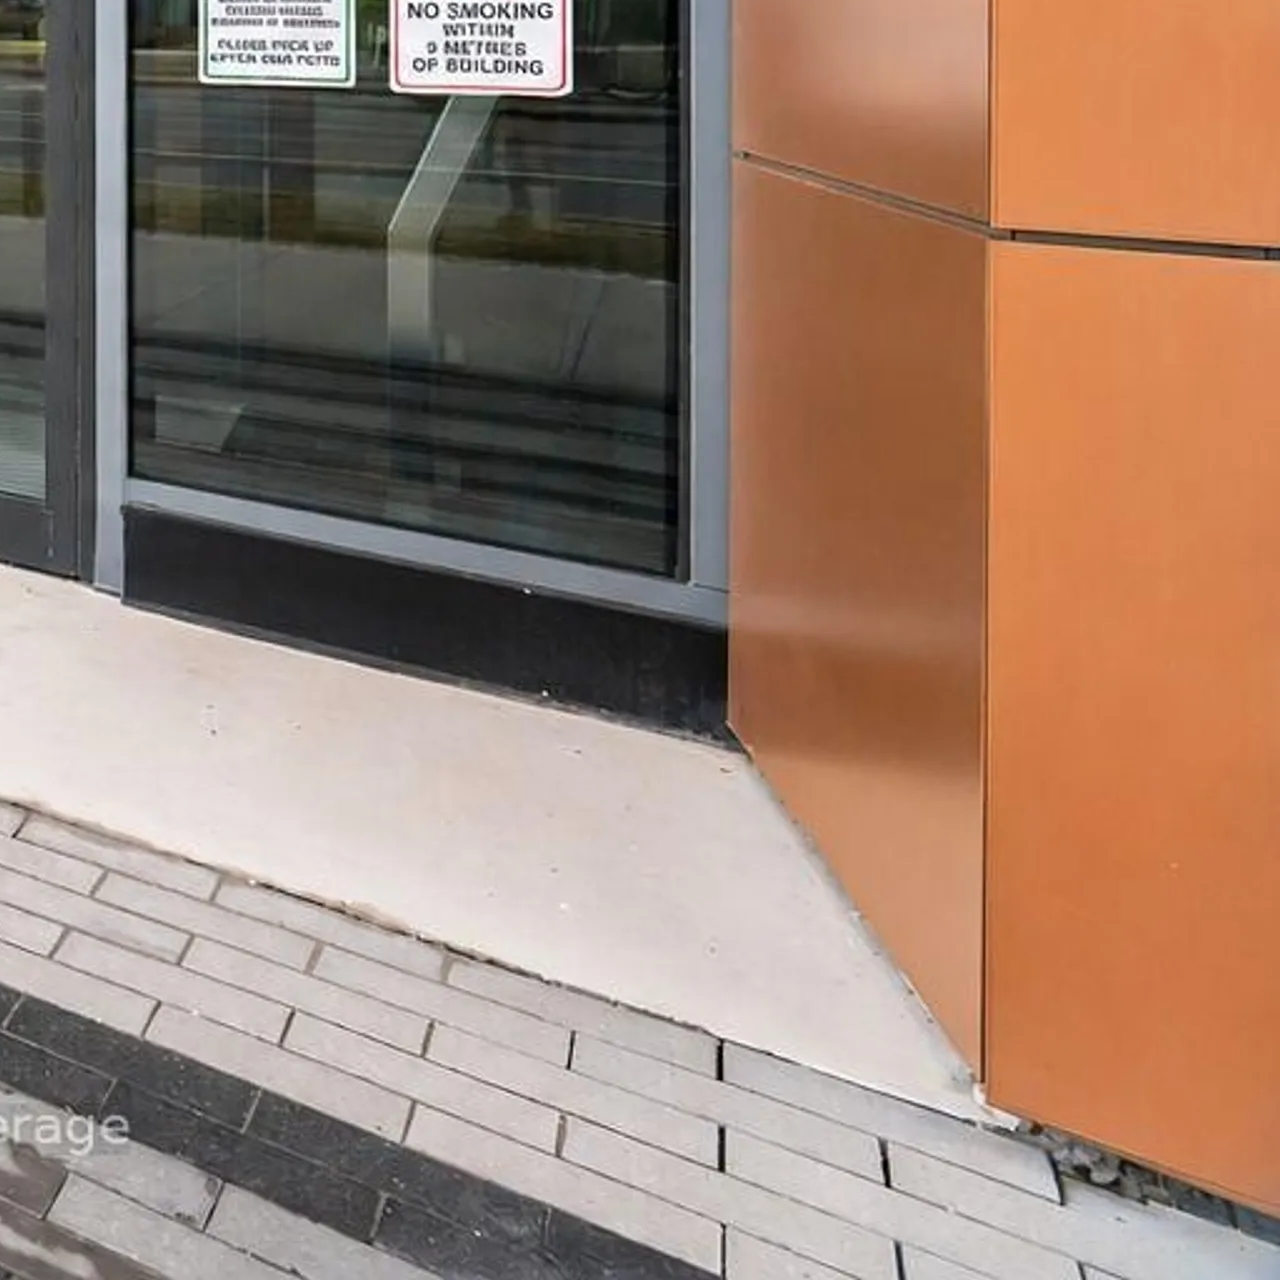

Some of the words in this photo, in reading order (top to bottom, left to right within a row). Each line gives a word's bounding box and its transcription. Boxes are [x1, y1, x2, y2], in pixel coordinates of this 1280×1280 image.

[407, 2, 439, 19] NO
[447, 2, 554, 20] SMOKING
[443, 22, 515, 38] WITHIN
[443, 40, 527, 56] METRES
[446, 57, 544, 75] BUILDING
